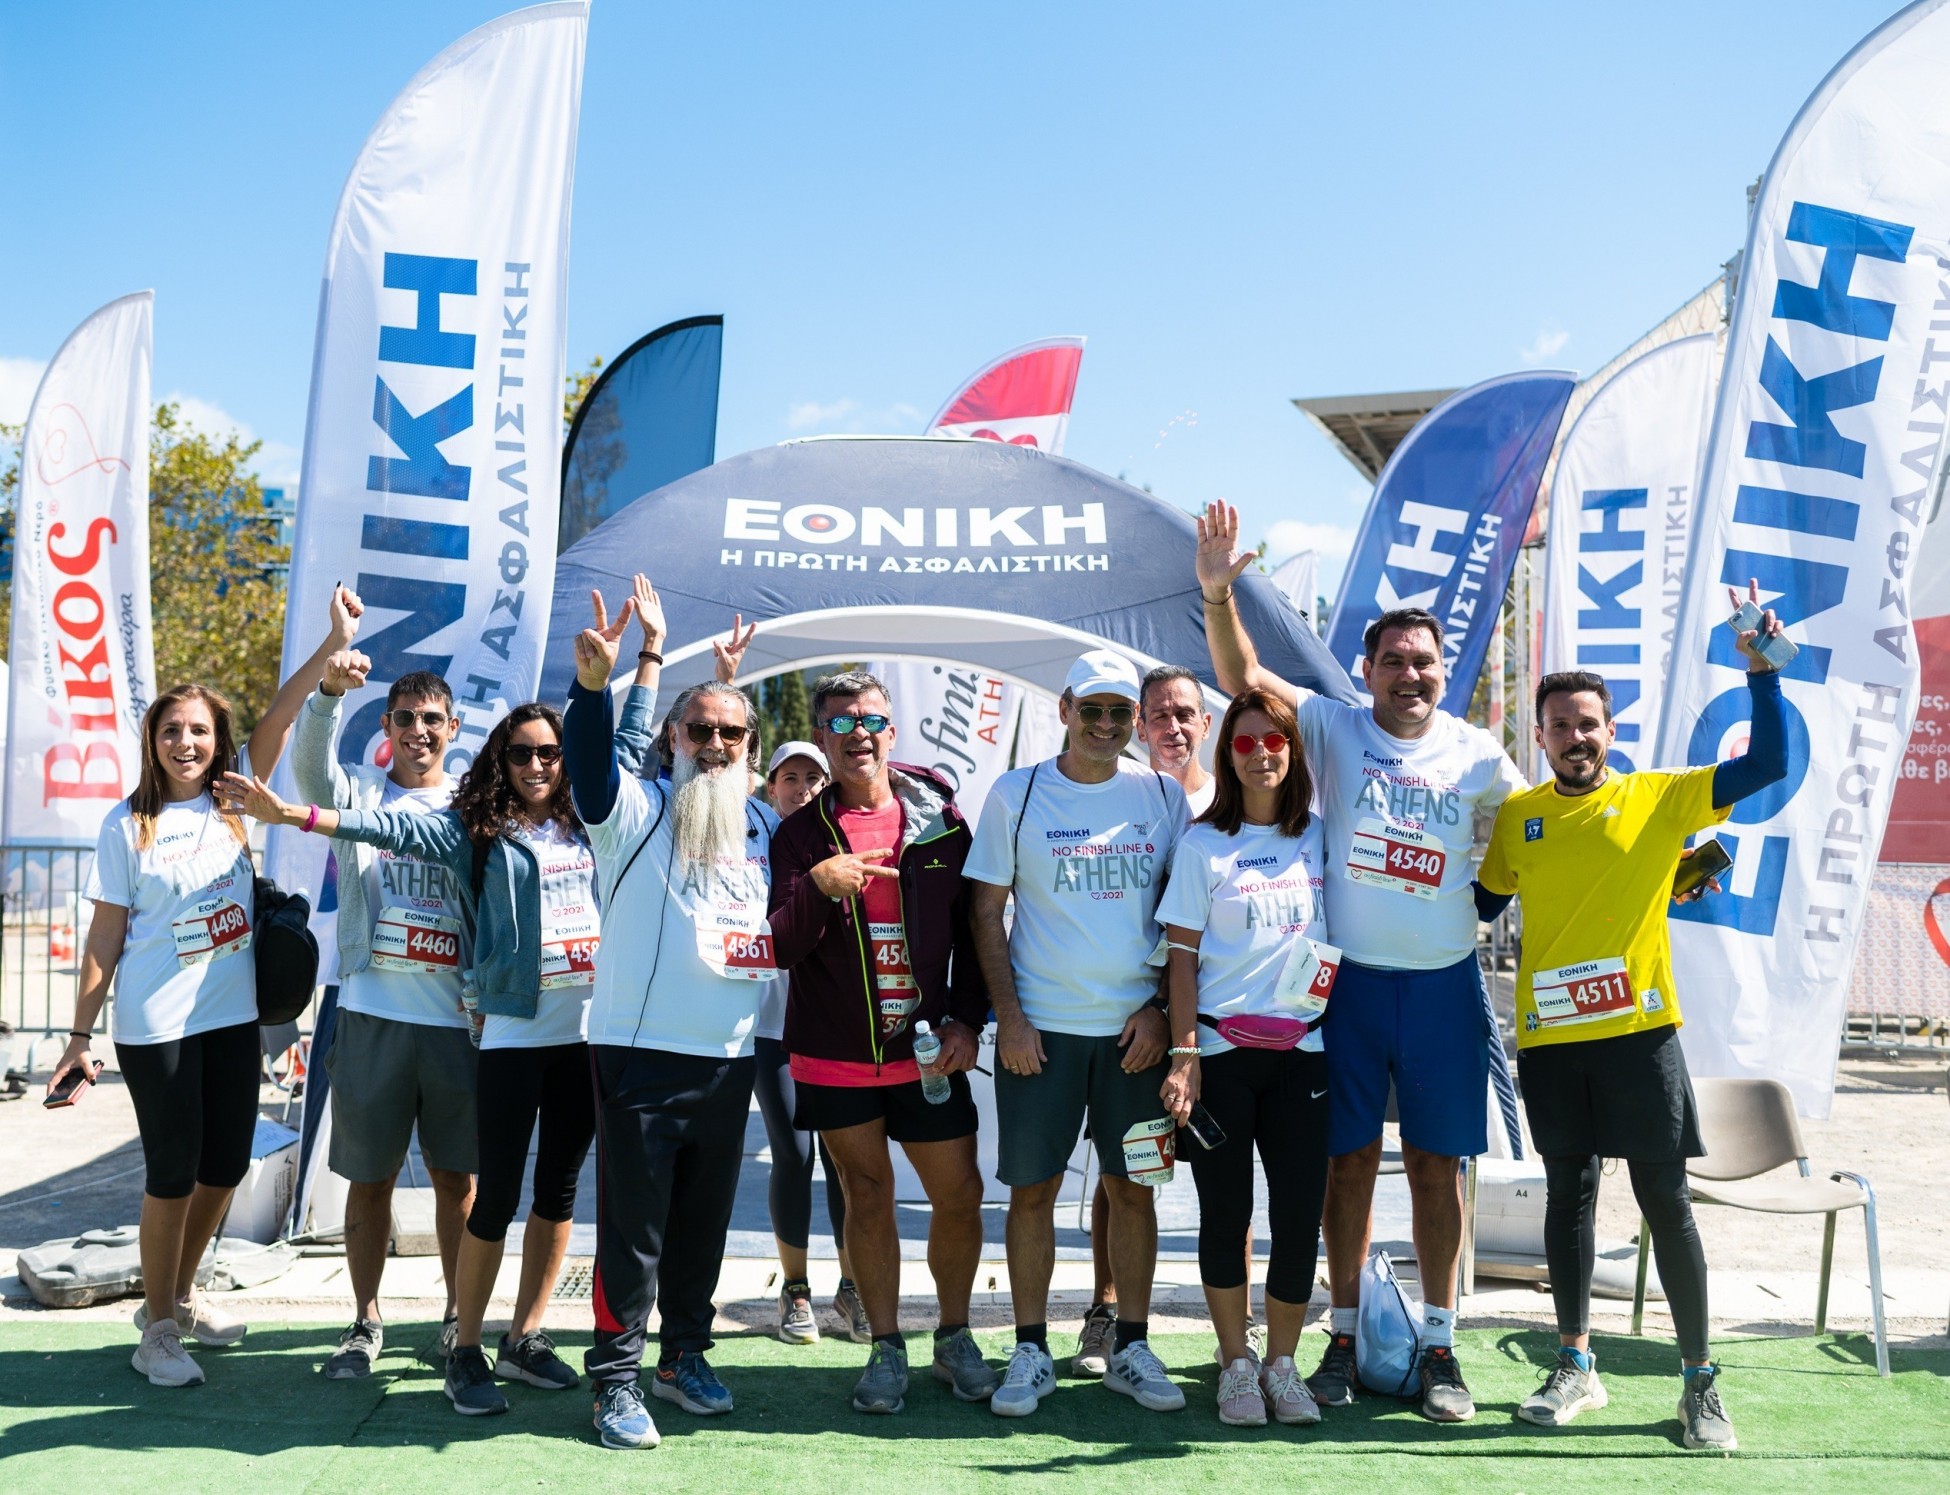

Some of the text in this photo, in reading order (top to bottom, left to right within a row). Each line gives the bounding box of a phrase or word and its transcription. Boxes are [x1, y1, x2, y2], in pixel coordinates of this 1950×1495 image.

[480, 262, 531, 661] ΑΣΦΑΛΙΣΤΙΚΗ
[720, 549, 1109, 574] Η ΠΡΩΤΗ ΑΣΦΑΛΙΣΤΙΚΗ
[977, 679, 1004, 745] ATH
[1920, 694, 1950, 712] ες,
[920, 666, 980, 774] fini
[1913, 719, 1942, 737] ες,
[1362, 767, 1382, 778] NO
[1816, 682, 1902, 885] ΠΡΩΤΗ
[1354, 777, 1460, 826] ATHENS
[1402, 820, 1424, 831] 2021
[1052, 846, 1072, 857] NO
[1074, 844, 1113, 857] FINISH
[1115, 843, 1142, 854] LINE
[1389, 847, 1441, 876] 4540
[574, 860, 595, 870] LIN
[1053, 854, 1154, 893] ATHENS
[215, 879, 234, 890] 2021
[382, 861, 459, 901] ATHEN
[1240, 883, 1260, 895] NO
[1262, 879, 1297, 891] FINISH
[422, 900, 443, 909] 2021
[1102, 891, 1124, 899] 2021
[211, 907, 244, 938] 4498
[410, 931, 456, 957] 4460
[727, 935, 769, 960] 4561
[1575, 977, 1626, 1005] 4511
[1515, 1189, 1528, 1198] A4
